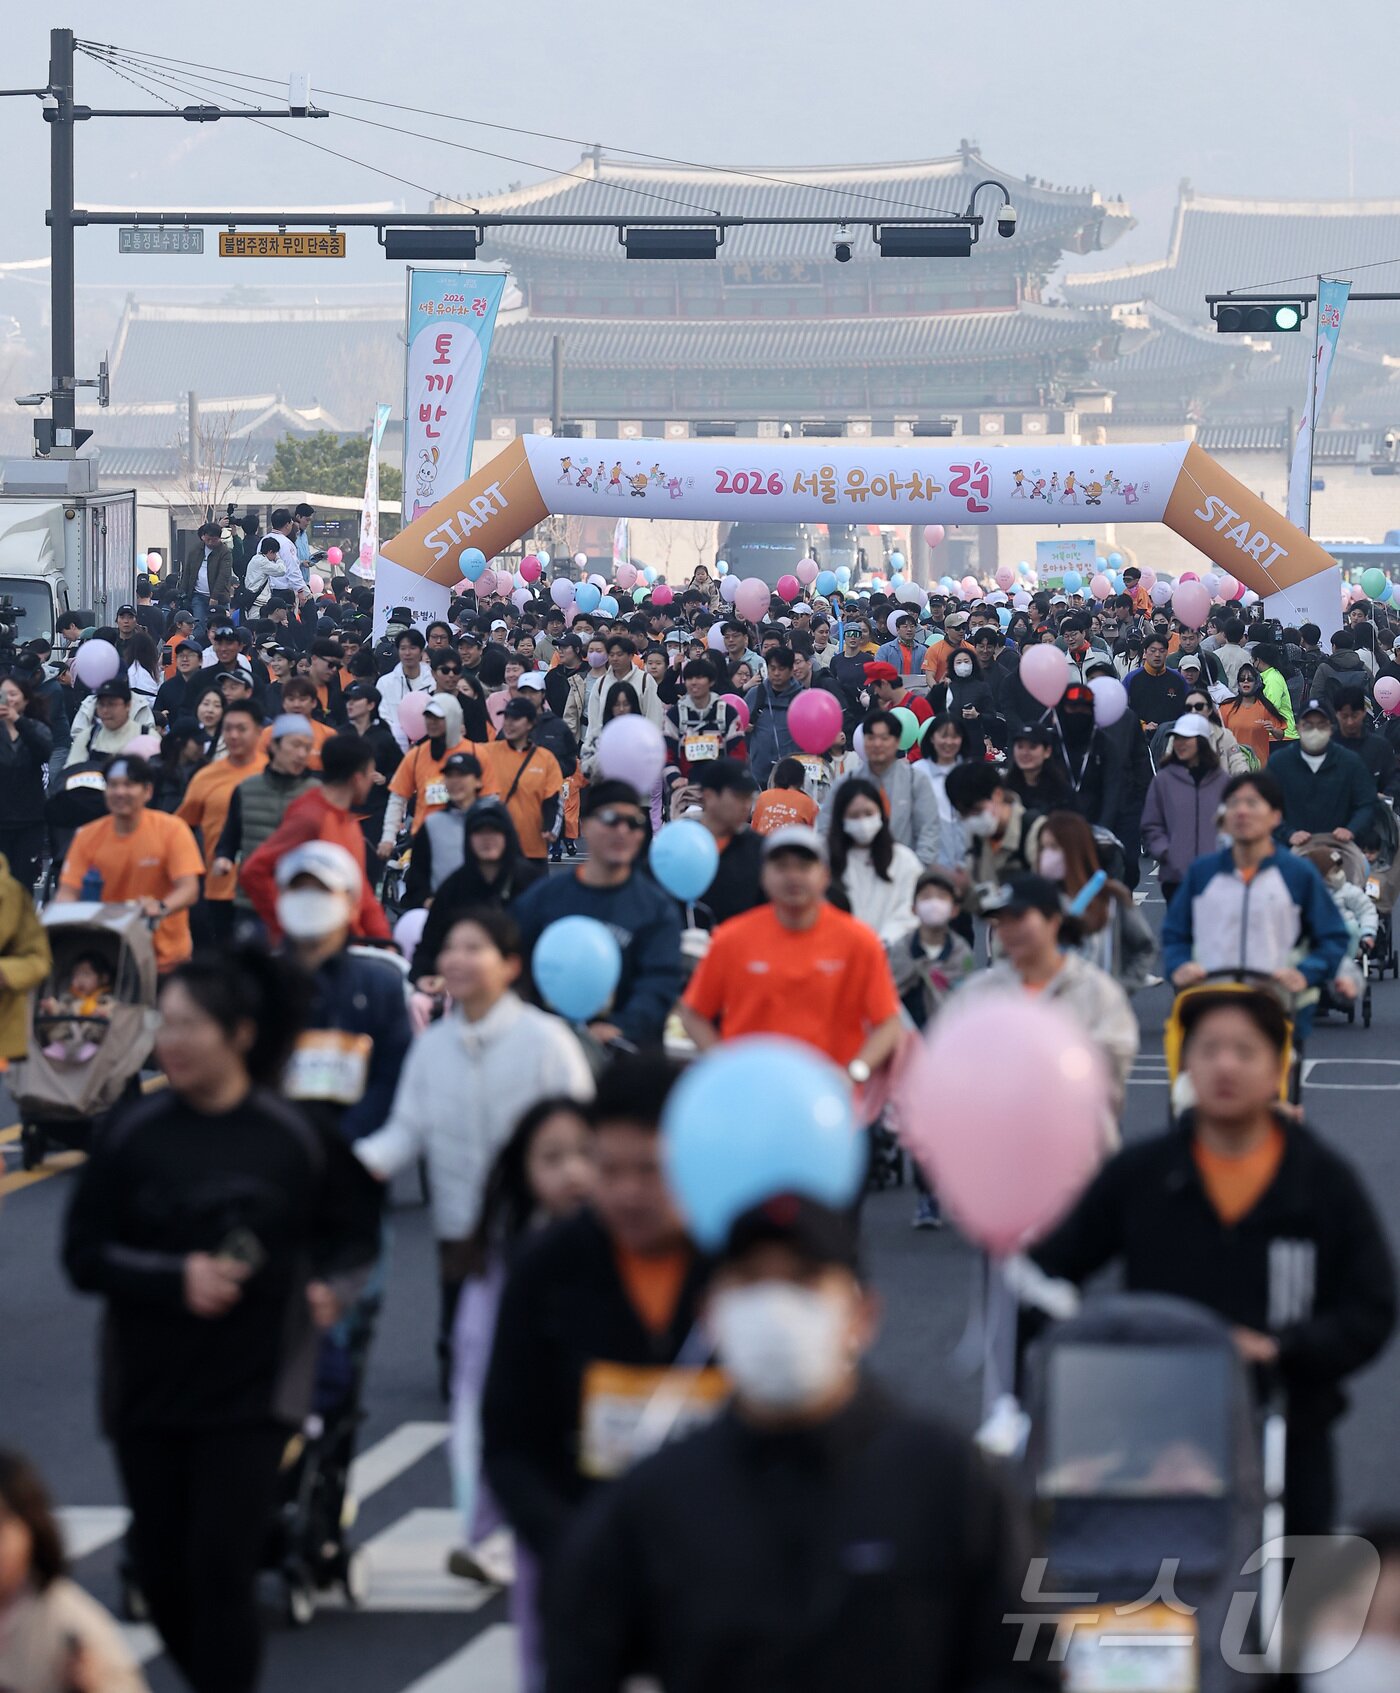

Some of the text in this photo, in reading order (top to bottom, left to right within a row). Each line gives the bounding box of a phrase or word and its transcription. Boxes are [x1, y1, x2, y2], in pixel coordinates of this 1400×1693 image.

[123, 232, 200, 249] 교통정보수집장치
[224, 237, 340, 254] 불법주정차 무인 단속중
[419, 298, 487, 317] 서울 유아차 런
[443, 294, 465, 302] 2026
[419, 333, 453, 438] 토끼반
[715, 461, 989, 512] 2026 서울 유아차 런
[423, 481, 508, 561] START
[1194, 495, 1289, 569] START
